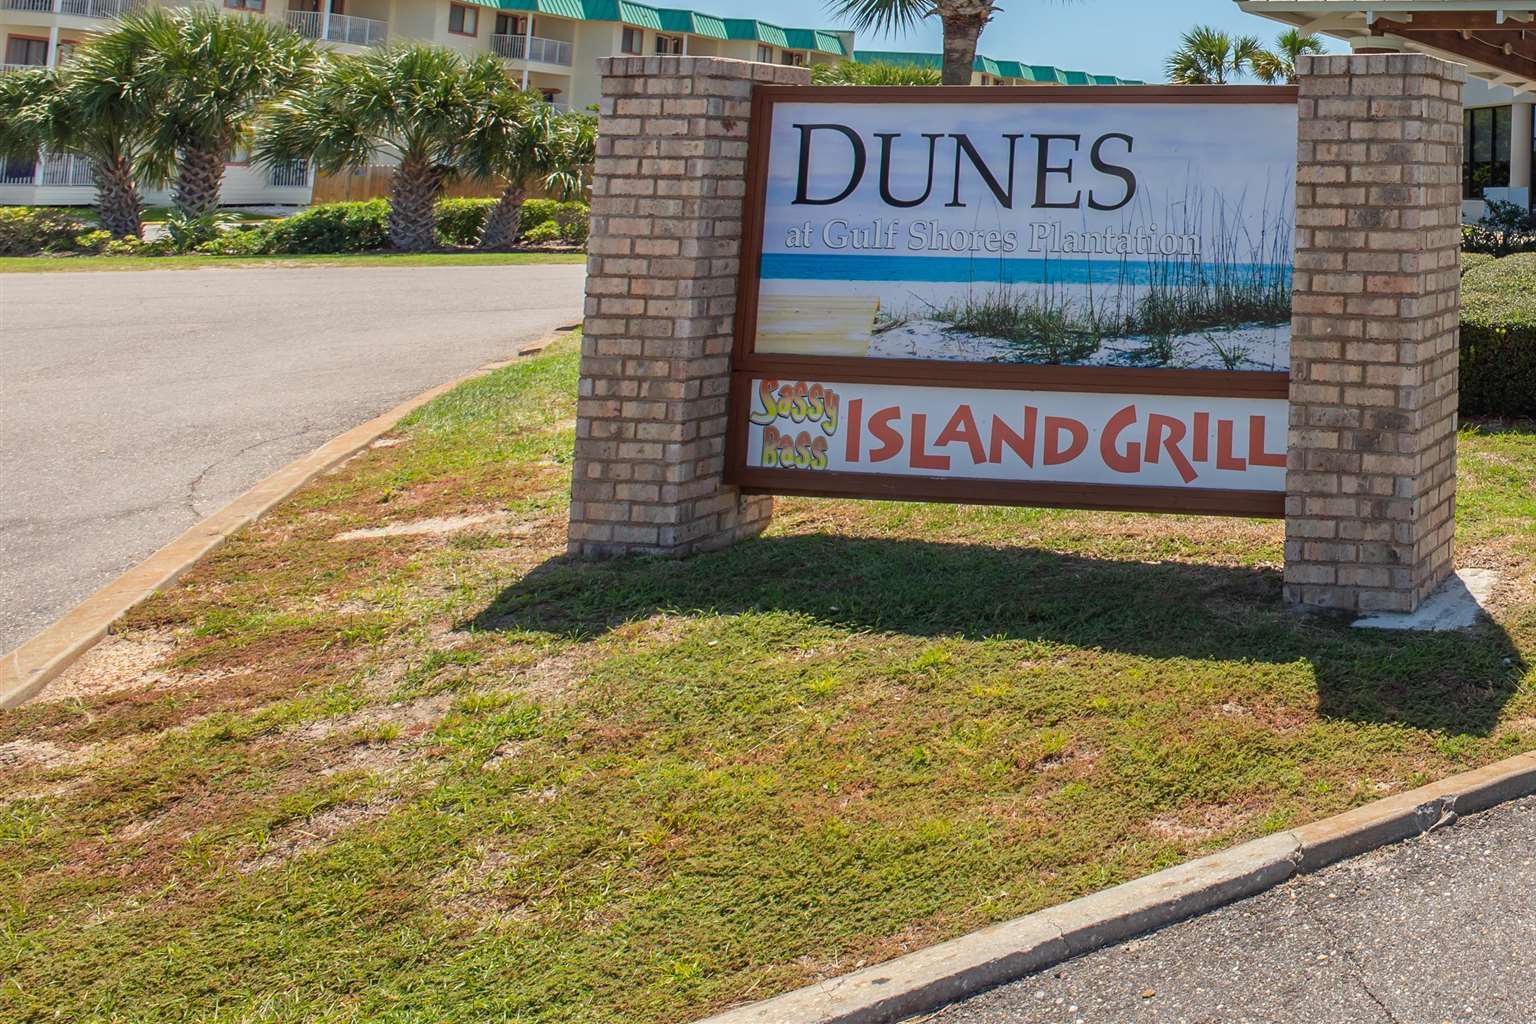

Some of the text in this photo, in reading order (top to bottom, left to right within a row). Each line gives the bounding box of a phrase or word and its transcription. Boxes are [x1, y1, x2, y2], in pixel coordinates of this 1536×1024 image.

[790, 122, 1138, 211] DUNES
[785, 218, 1201, 257] at Gulf Shores Plantation
[748, 378, 840, 436] Sassy
[844, 398, 1288, 484] ISLAND GRILL
